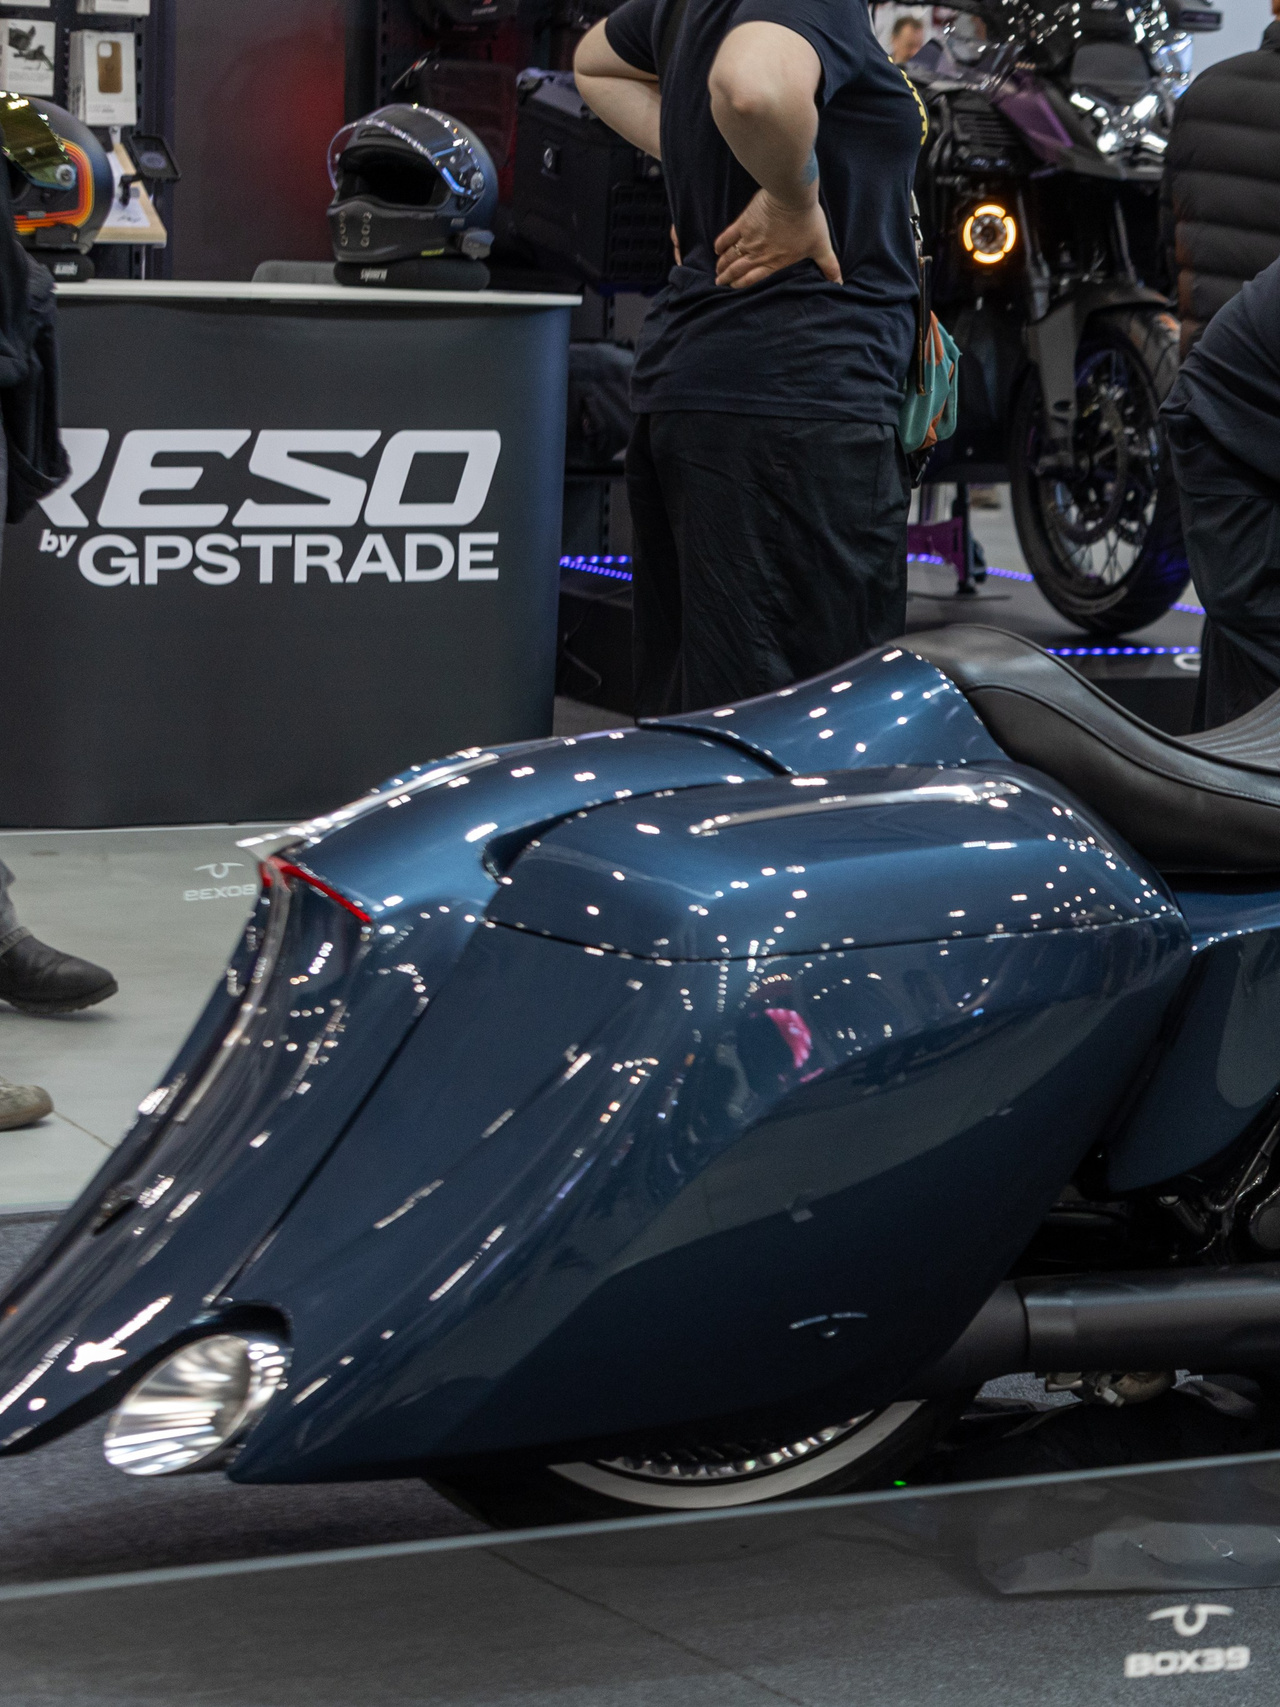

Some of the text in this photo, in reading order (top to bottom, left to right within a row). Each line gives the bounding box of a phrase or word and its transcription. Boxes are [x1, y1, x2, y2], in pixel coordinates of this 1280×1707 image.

[39, 529, 499, 586] by GPSTRADE
[1124, 1646, 1250, 1678] BOX39
